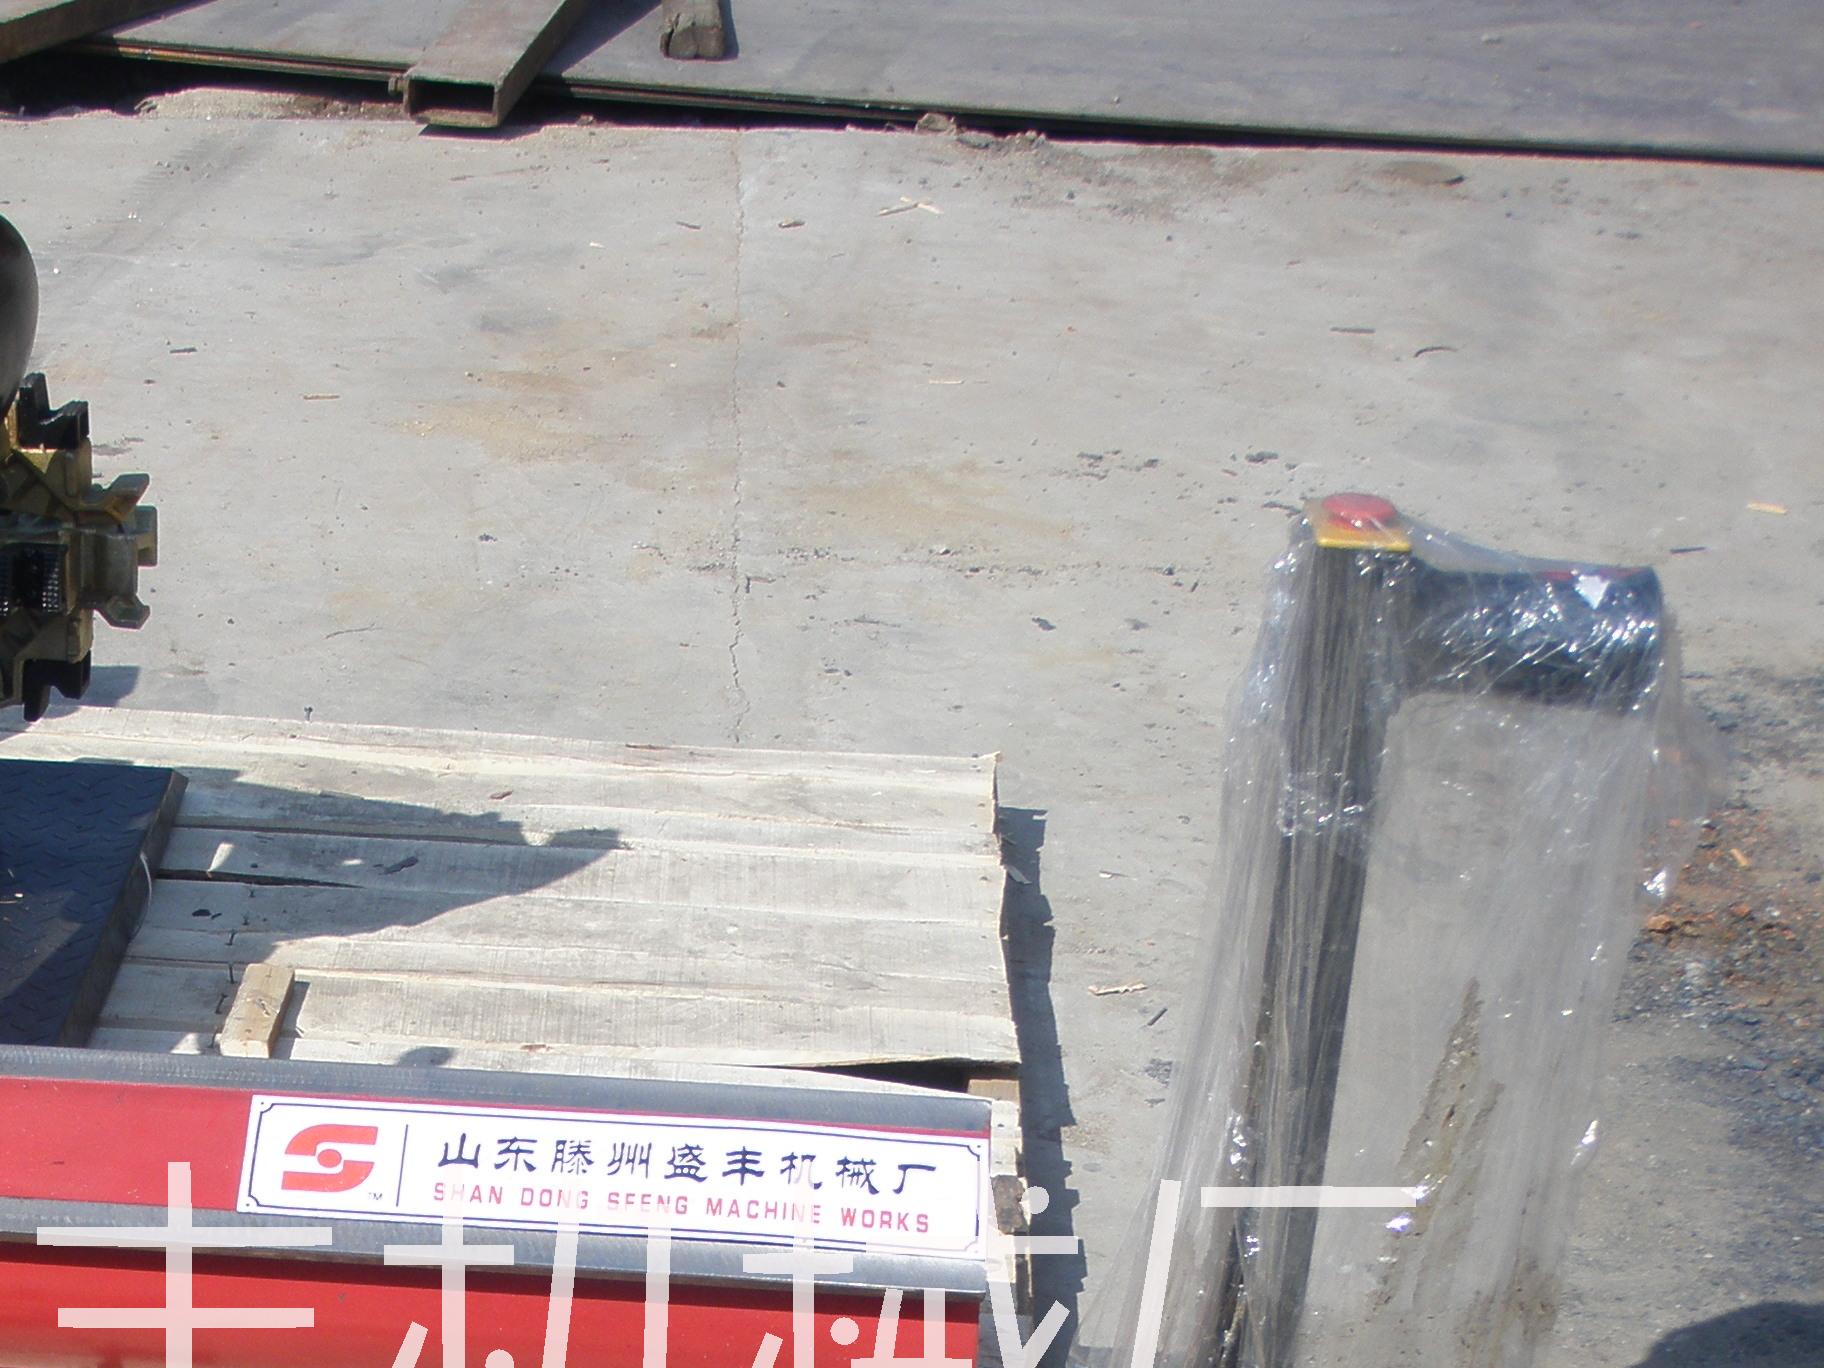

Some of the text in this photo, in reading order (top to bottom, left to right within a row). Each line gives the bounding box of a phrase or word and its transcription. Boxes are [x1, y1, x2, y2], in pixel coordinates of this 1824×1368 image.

[437, 1132, 938, 1195] 山东滕州盛丰机械厂
[432, 1181, 930, 1233] SHAN DONG SFENG MACHINE WORKS
